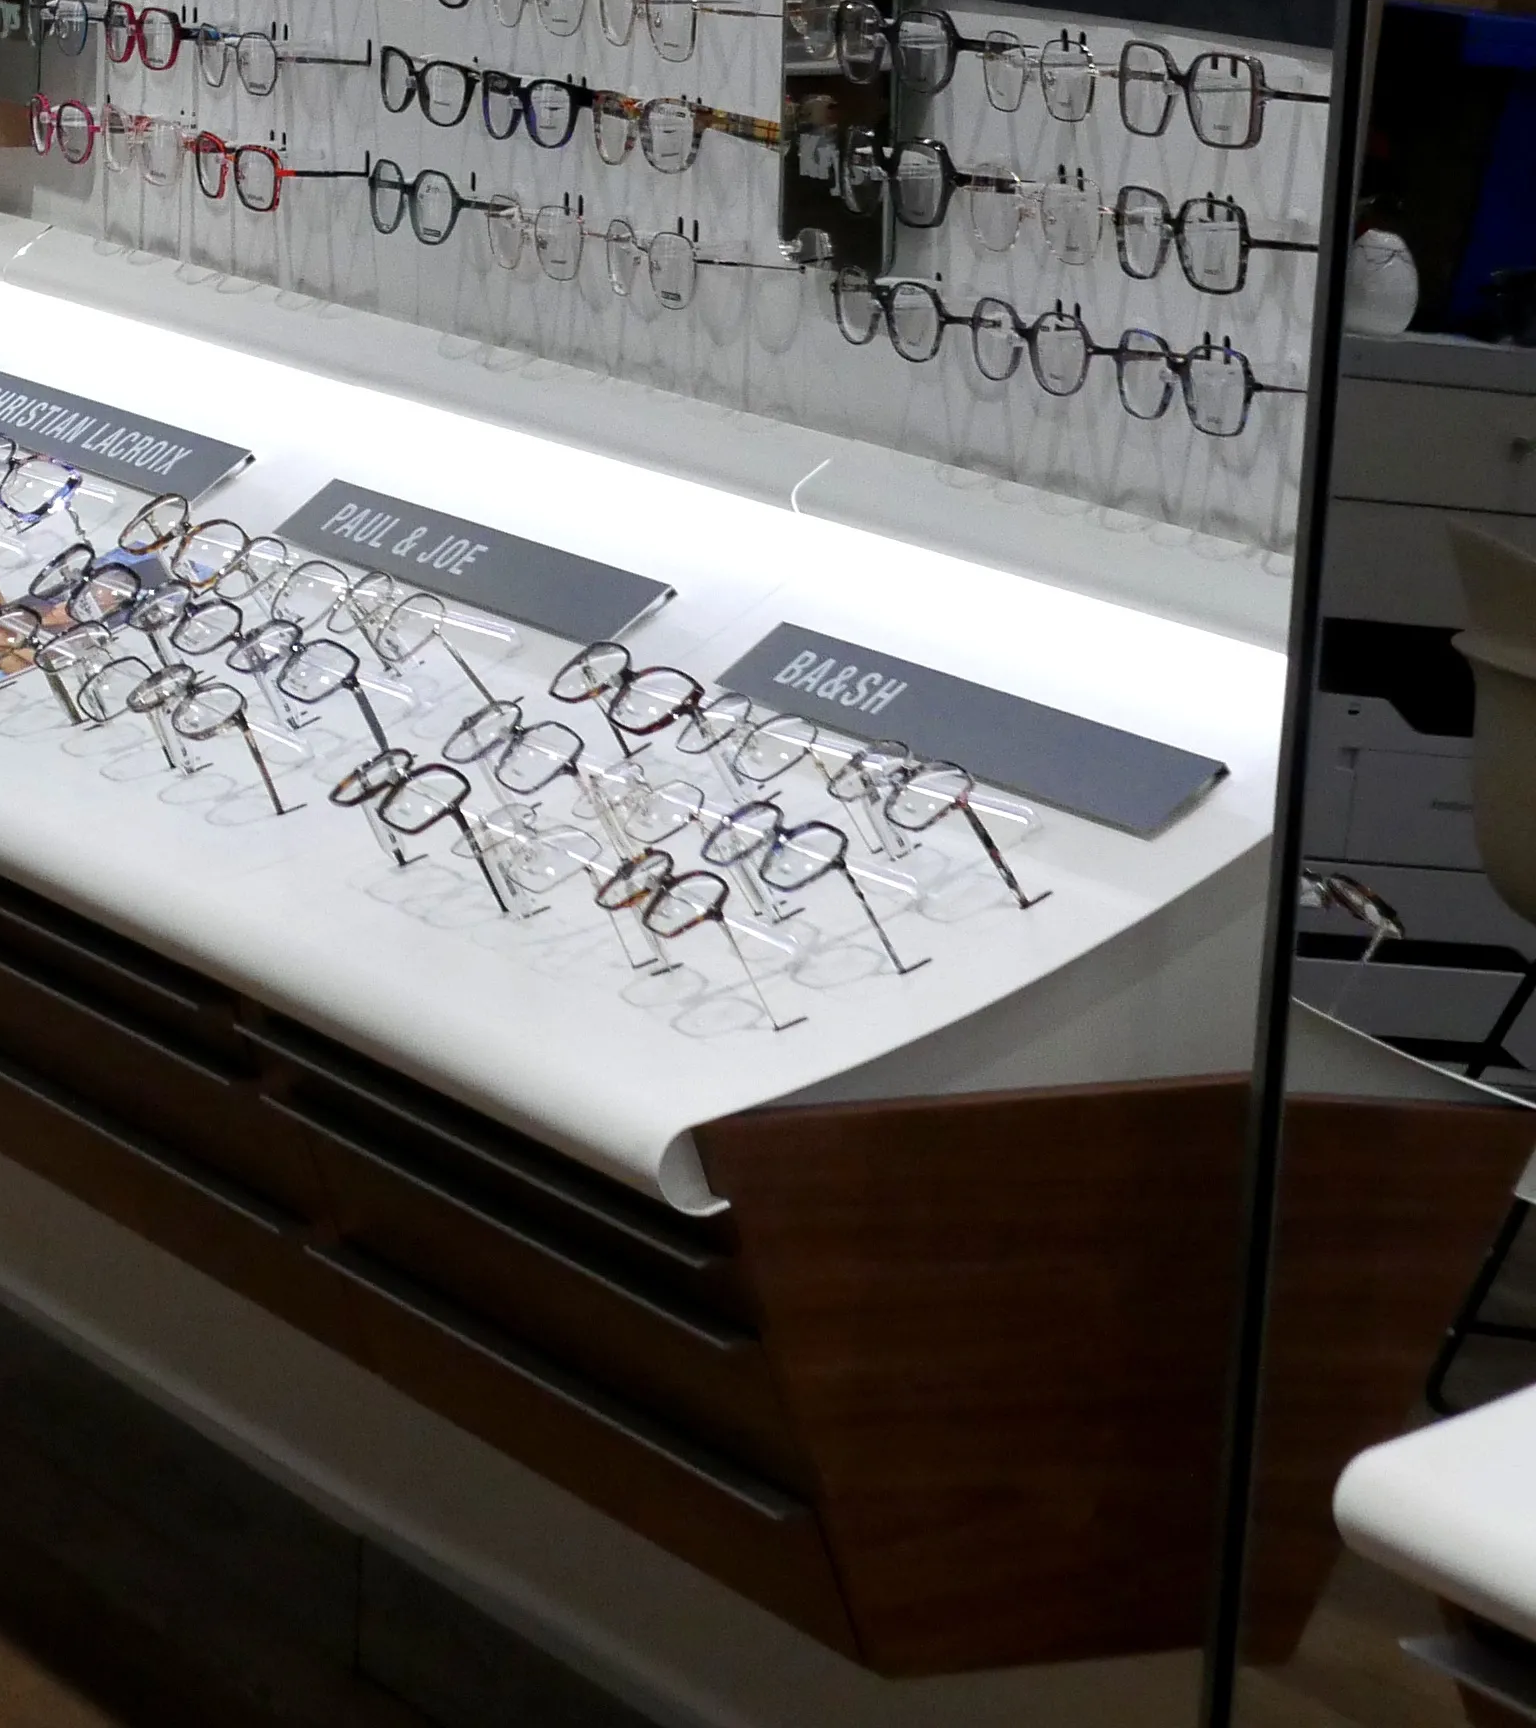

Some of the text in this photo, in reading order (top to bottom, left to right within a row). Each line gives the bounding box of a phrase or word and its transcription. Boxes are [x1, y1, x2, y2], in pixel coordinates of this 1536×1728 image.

[82, 422, 194, 476] LACROIX
[321, 502, 490, 576] PAUL & JOE
[773, 650, 908, 714] BA&SH
